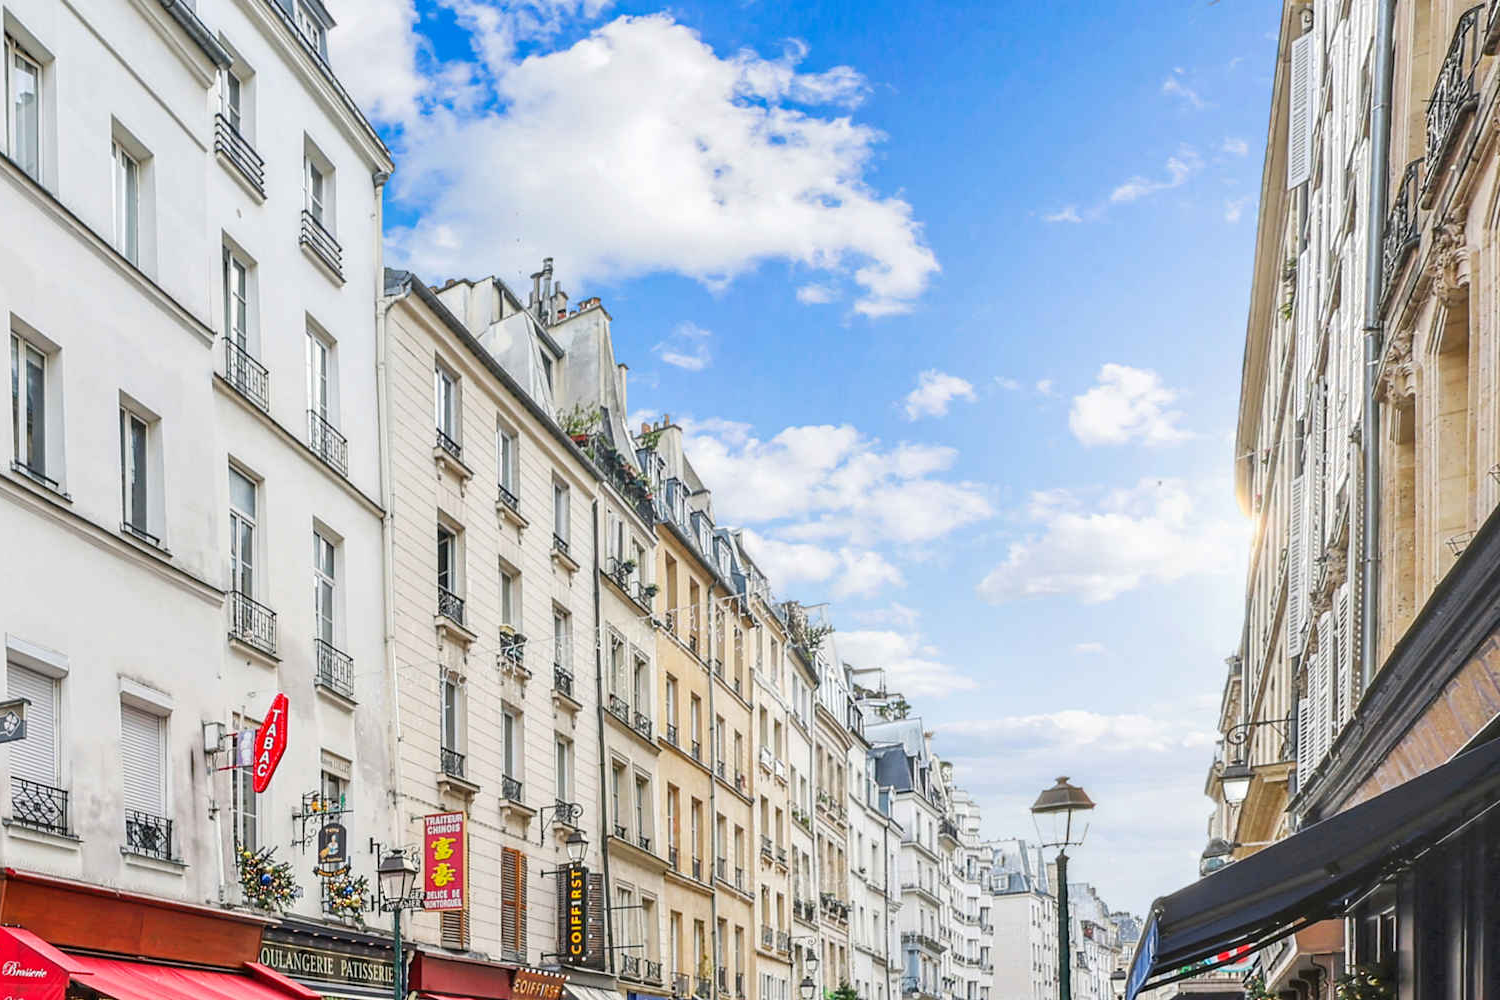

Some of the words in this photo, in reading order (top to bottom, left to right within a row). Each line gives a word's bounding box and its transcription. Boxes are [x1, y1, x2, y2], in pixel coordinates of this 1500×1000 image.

[257, 709, 281, 777] TABAC
[425, 814, 462, 826] TRAITEUR
[427, 823, 460, 835] CHINOIS
[426, 890, 448, 900] DELICE
[2, 960, 48, 978] Brasserie
[258, 946, 334, 975] OULANGERIE
[340, 959, 394, 983] PATISSERIE
